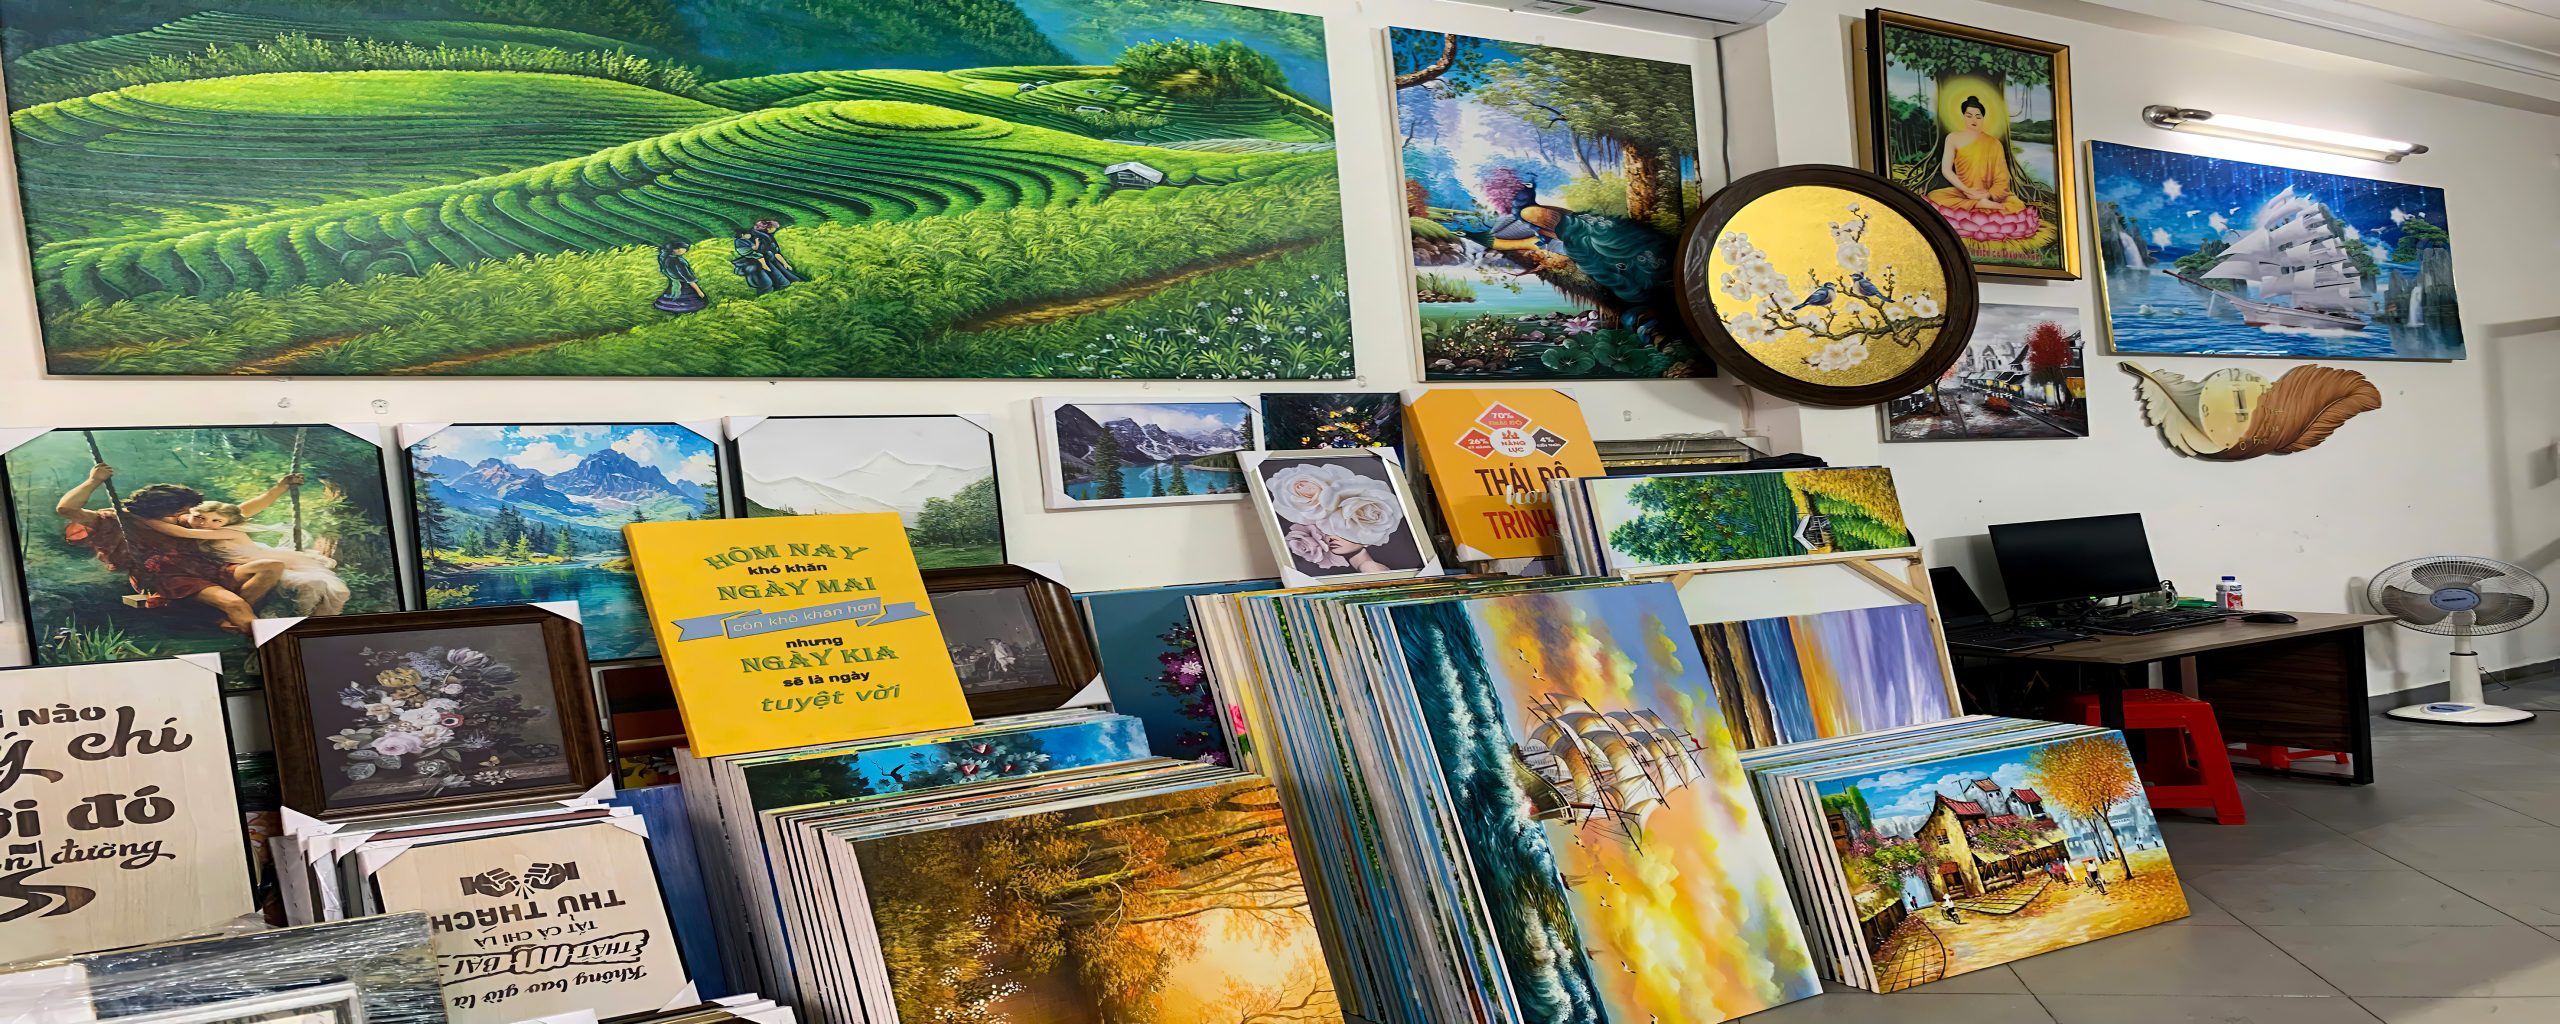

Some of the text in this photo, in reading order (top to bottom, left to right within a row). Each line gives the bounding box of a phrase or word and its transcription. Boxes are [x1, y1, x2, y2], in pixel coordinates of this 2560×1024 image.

[2227, 367, 2241, 382] 12
[1474, 462, 1536, 496] THÁI
[1482, 504, 1560, 540] TRÌNH
[703, 543, 869, 571] HÔM NAY
[747, 562, 828, 577] khó khăn
[715, 576, 877, 601] NGÀY MAI
[785, 634, 844, 650] nhưng
[740, 645, 900, 674] NGÀY KIA
[782, 670, 870, 688] sẽ là ngày
[761, 684, 901, 714] tuyệt vời
[18, 703, 107, 727] Nào
[67, 705, 193, 762] chí
[66, 784, 176, 831] đó
[50, 838, 177, 870] đường
[431, 889, 627, 935] THỬ THÁCH
[473, 920, 599, 949] TẤT CẢ CHỈ LÀ
[454, 940, 632, 977] THẤT BẠI
[452, 964, 648, 1009] Không bao giờ là
